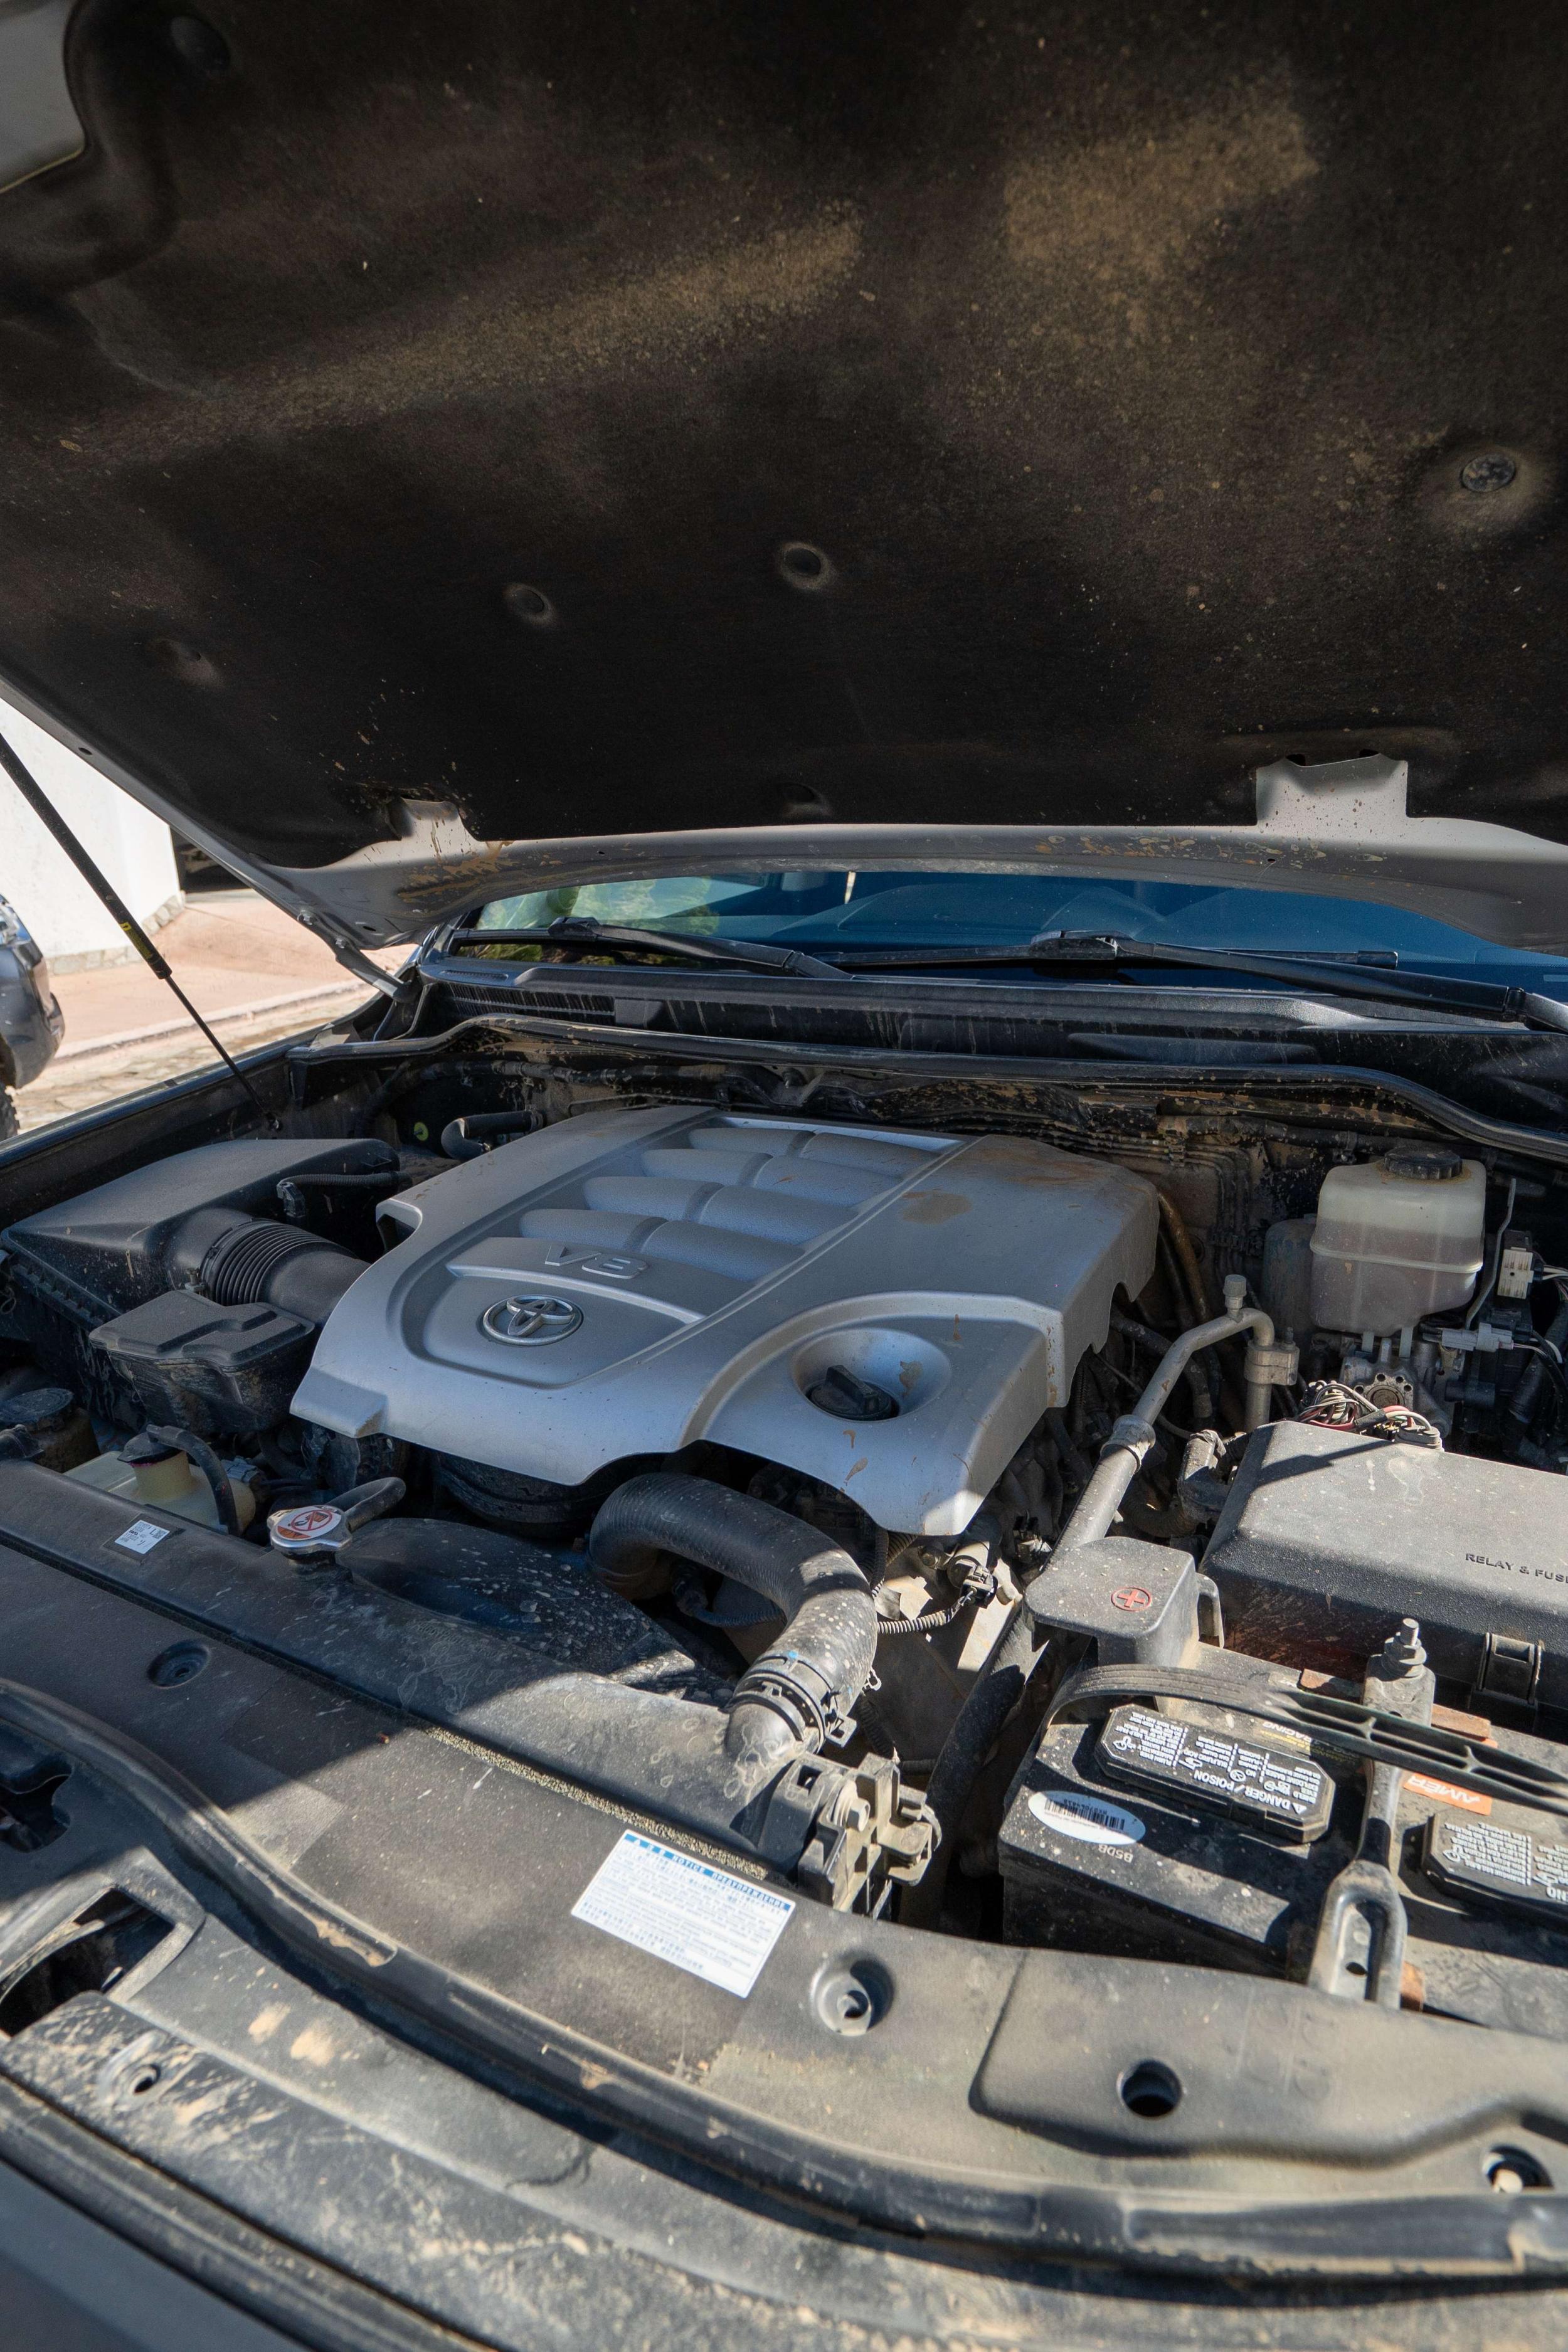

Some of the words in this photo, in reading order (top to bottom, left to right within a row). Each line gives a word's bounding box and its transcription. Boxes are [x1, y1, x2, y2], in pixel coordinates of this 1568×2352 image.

[544, 1244, 649, 1279] V8
[1465, 1553, 1513, 1571] RELAY
[1519, 1565, 1529, 1574] &
[1198, 1754, 1228, 1767] SULFURIC
[1194, 1771, 1234, 1791] POISON
[1244, 1786, 1291, 1810] DANGER
[672, 1853, 706, 1874] NOTICE
[1098, 1844, 1133, 1863] B5DB
